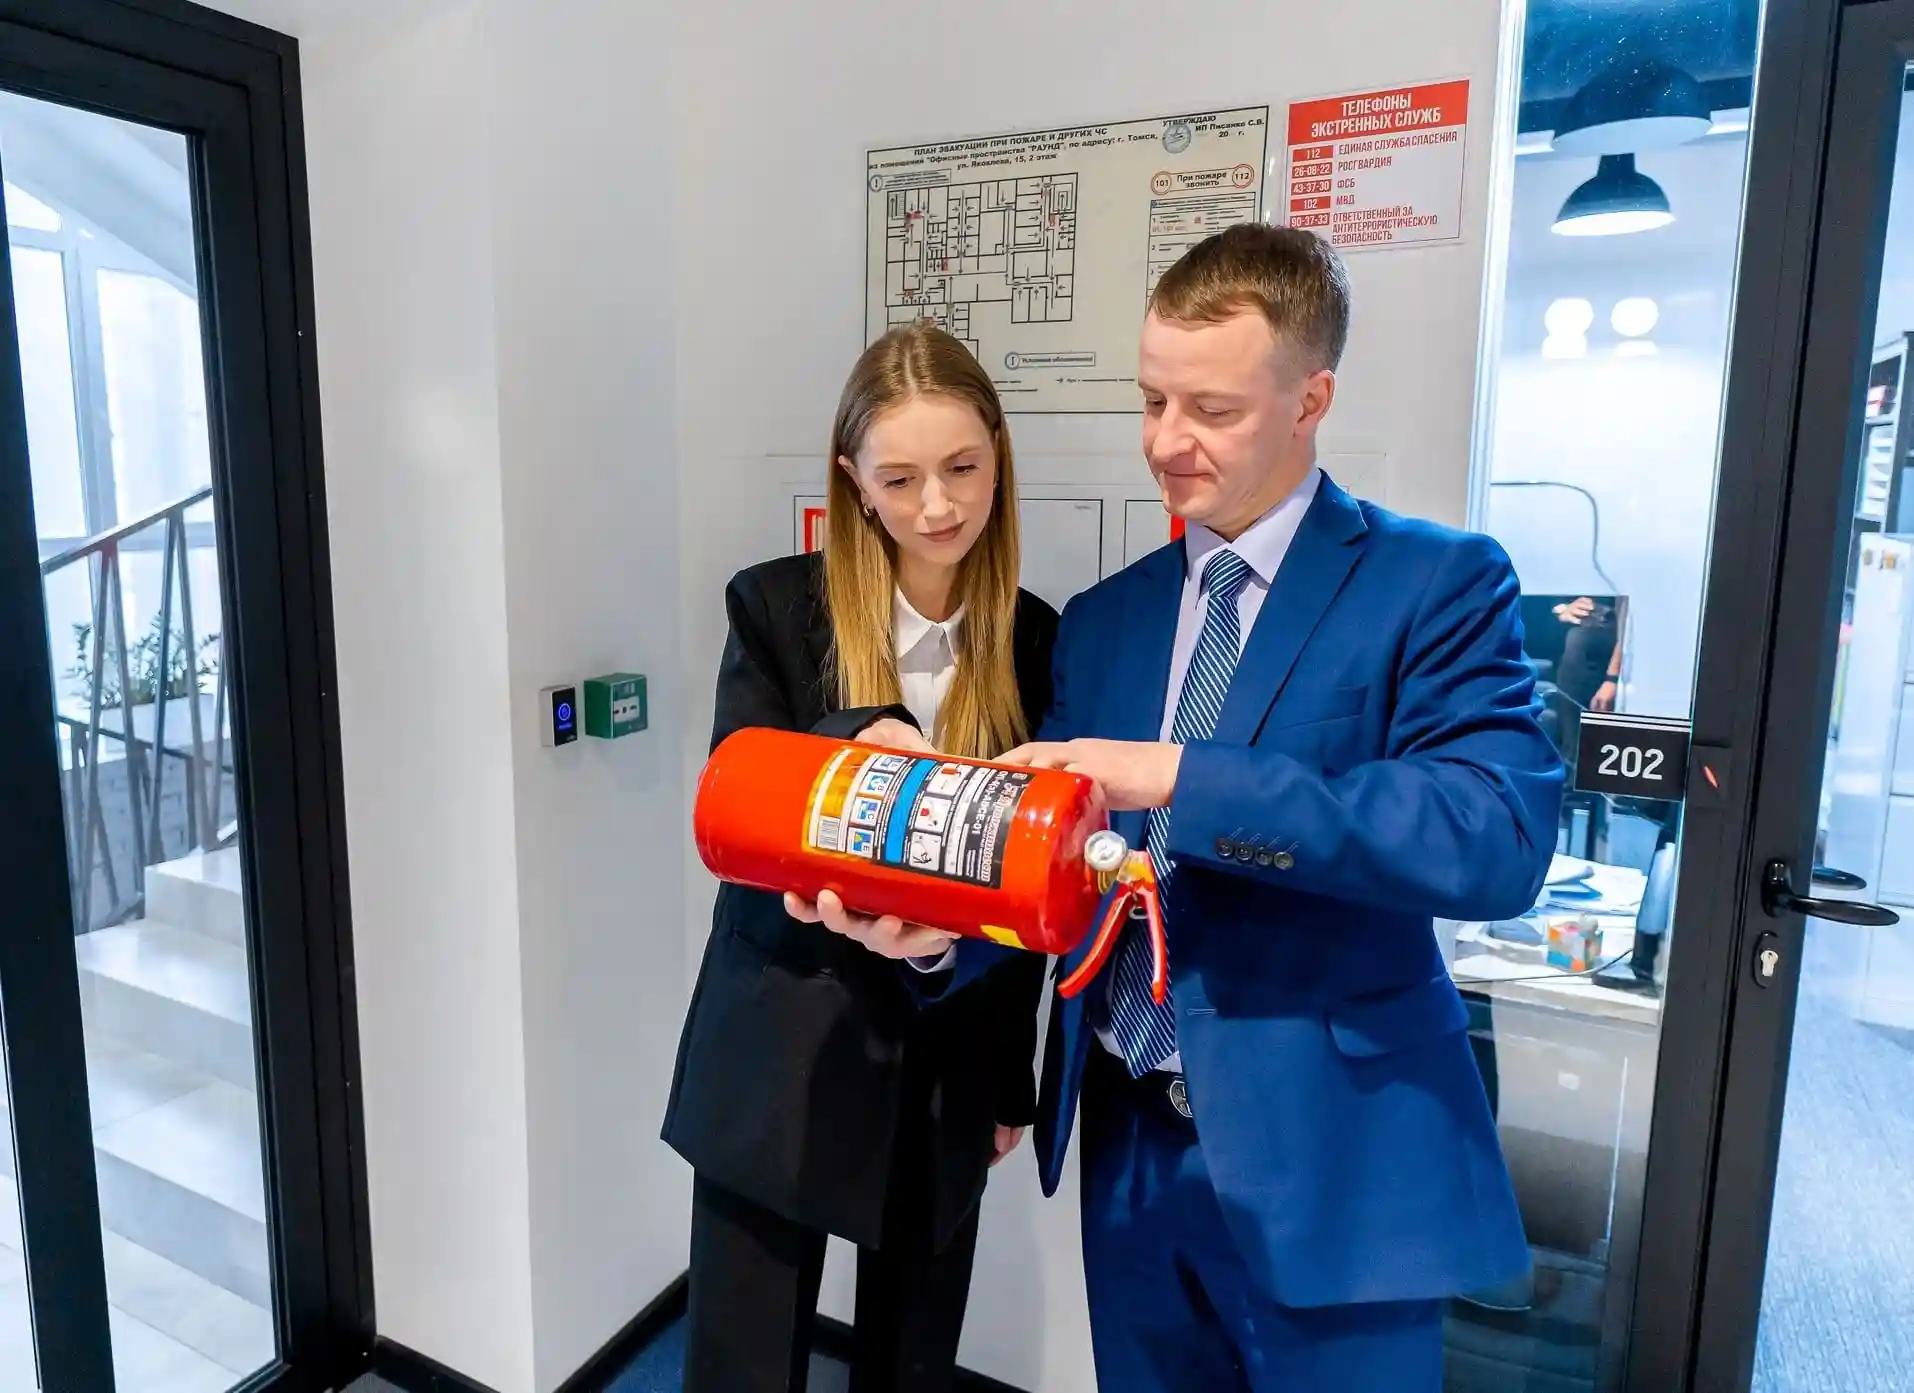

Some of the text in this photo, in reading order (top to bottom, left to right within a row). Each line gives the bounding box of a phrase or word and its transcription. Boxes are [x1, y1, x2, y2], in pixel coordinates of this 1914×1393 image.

[1341, 93, 1411, 117] ТЕЛЕФОНЫ
[1162, 115, 1217, 128] УТВЕРЖДАЮ
[1311, 107, 1441, 138] ЭКСТРЕННЫХ СЛУЖБ
[914, 128, 1108, 156] ПЛАН ЭВАКУАЦИИ ПРИ ПОЖАРЕ И ДРУГИХ ЧС
[1218, 130, 1229, 138] 20
[1068, 141, 1079, 149] по
[1306, 131, 1457, 160] 112 ЕДИНАЯ СЛУЖБА СПАСЕНИЯ
[1028, 154, 1034, 162] 2
[1338, 156, 1392, 172] РОСГВАРДИЯ
[1155, 171, 1250, 188] 101 При пожаре 112
[1186, 180, 1220, 189] звонить
[1337, 178, 1356, 189] ФСБ
[1303, 195, 1355, 209] 102 МВД
[1291, 206, 1413, 227] 90-37-33 ОТВЕТСТВЕННЫЙ ЗА
[1332, 214, 1438, 234] АНТИТЕРРОРИСТИЧЕСКУЮ
[1332, 230, 1393, 245] БЕЗОПАСНОСТЬ
[1598, 744, 1665, 780] 202
